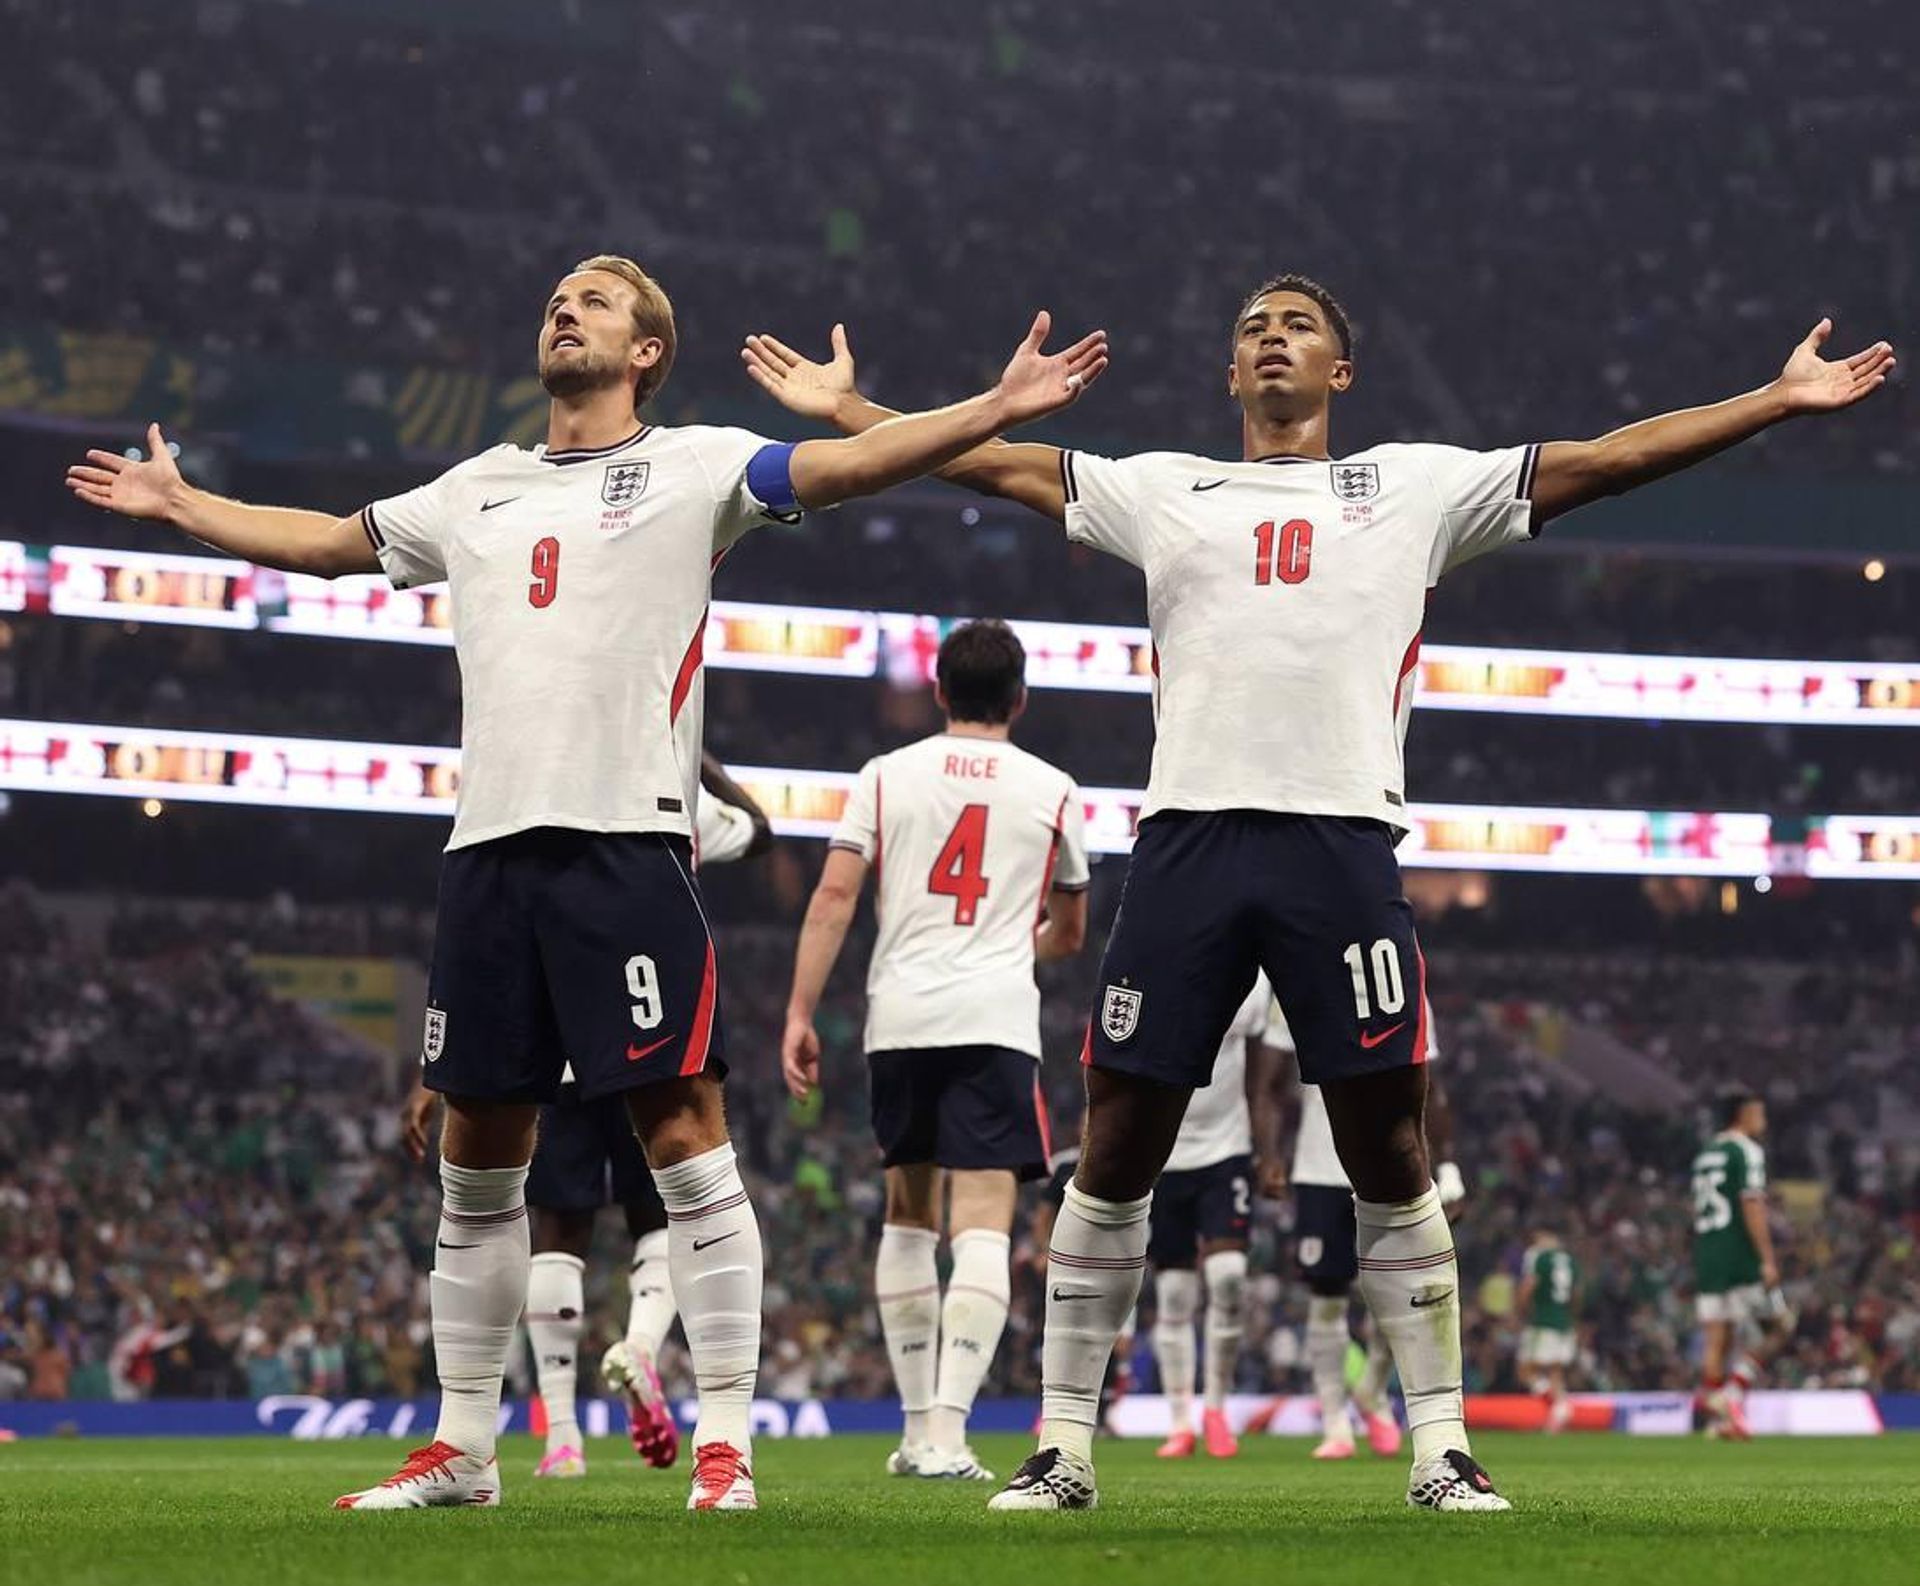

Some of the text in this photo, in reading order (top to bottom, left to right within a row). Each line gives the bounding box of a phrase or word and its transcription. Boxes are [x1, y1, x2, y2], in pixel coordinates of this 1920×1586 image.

[529, 536, 560, 608] 9
[1254, 519, 1313, 585] 10
[944, 755, 999, 779] RICE
[928, 804, 990, 925] 4
[624, 953, 664, 1031] 9
[1343, 937, 1405, 1020] 10
[1231, 1176, 1251, 1215] 2
